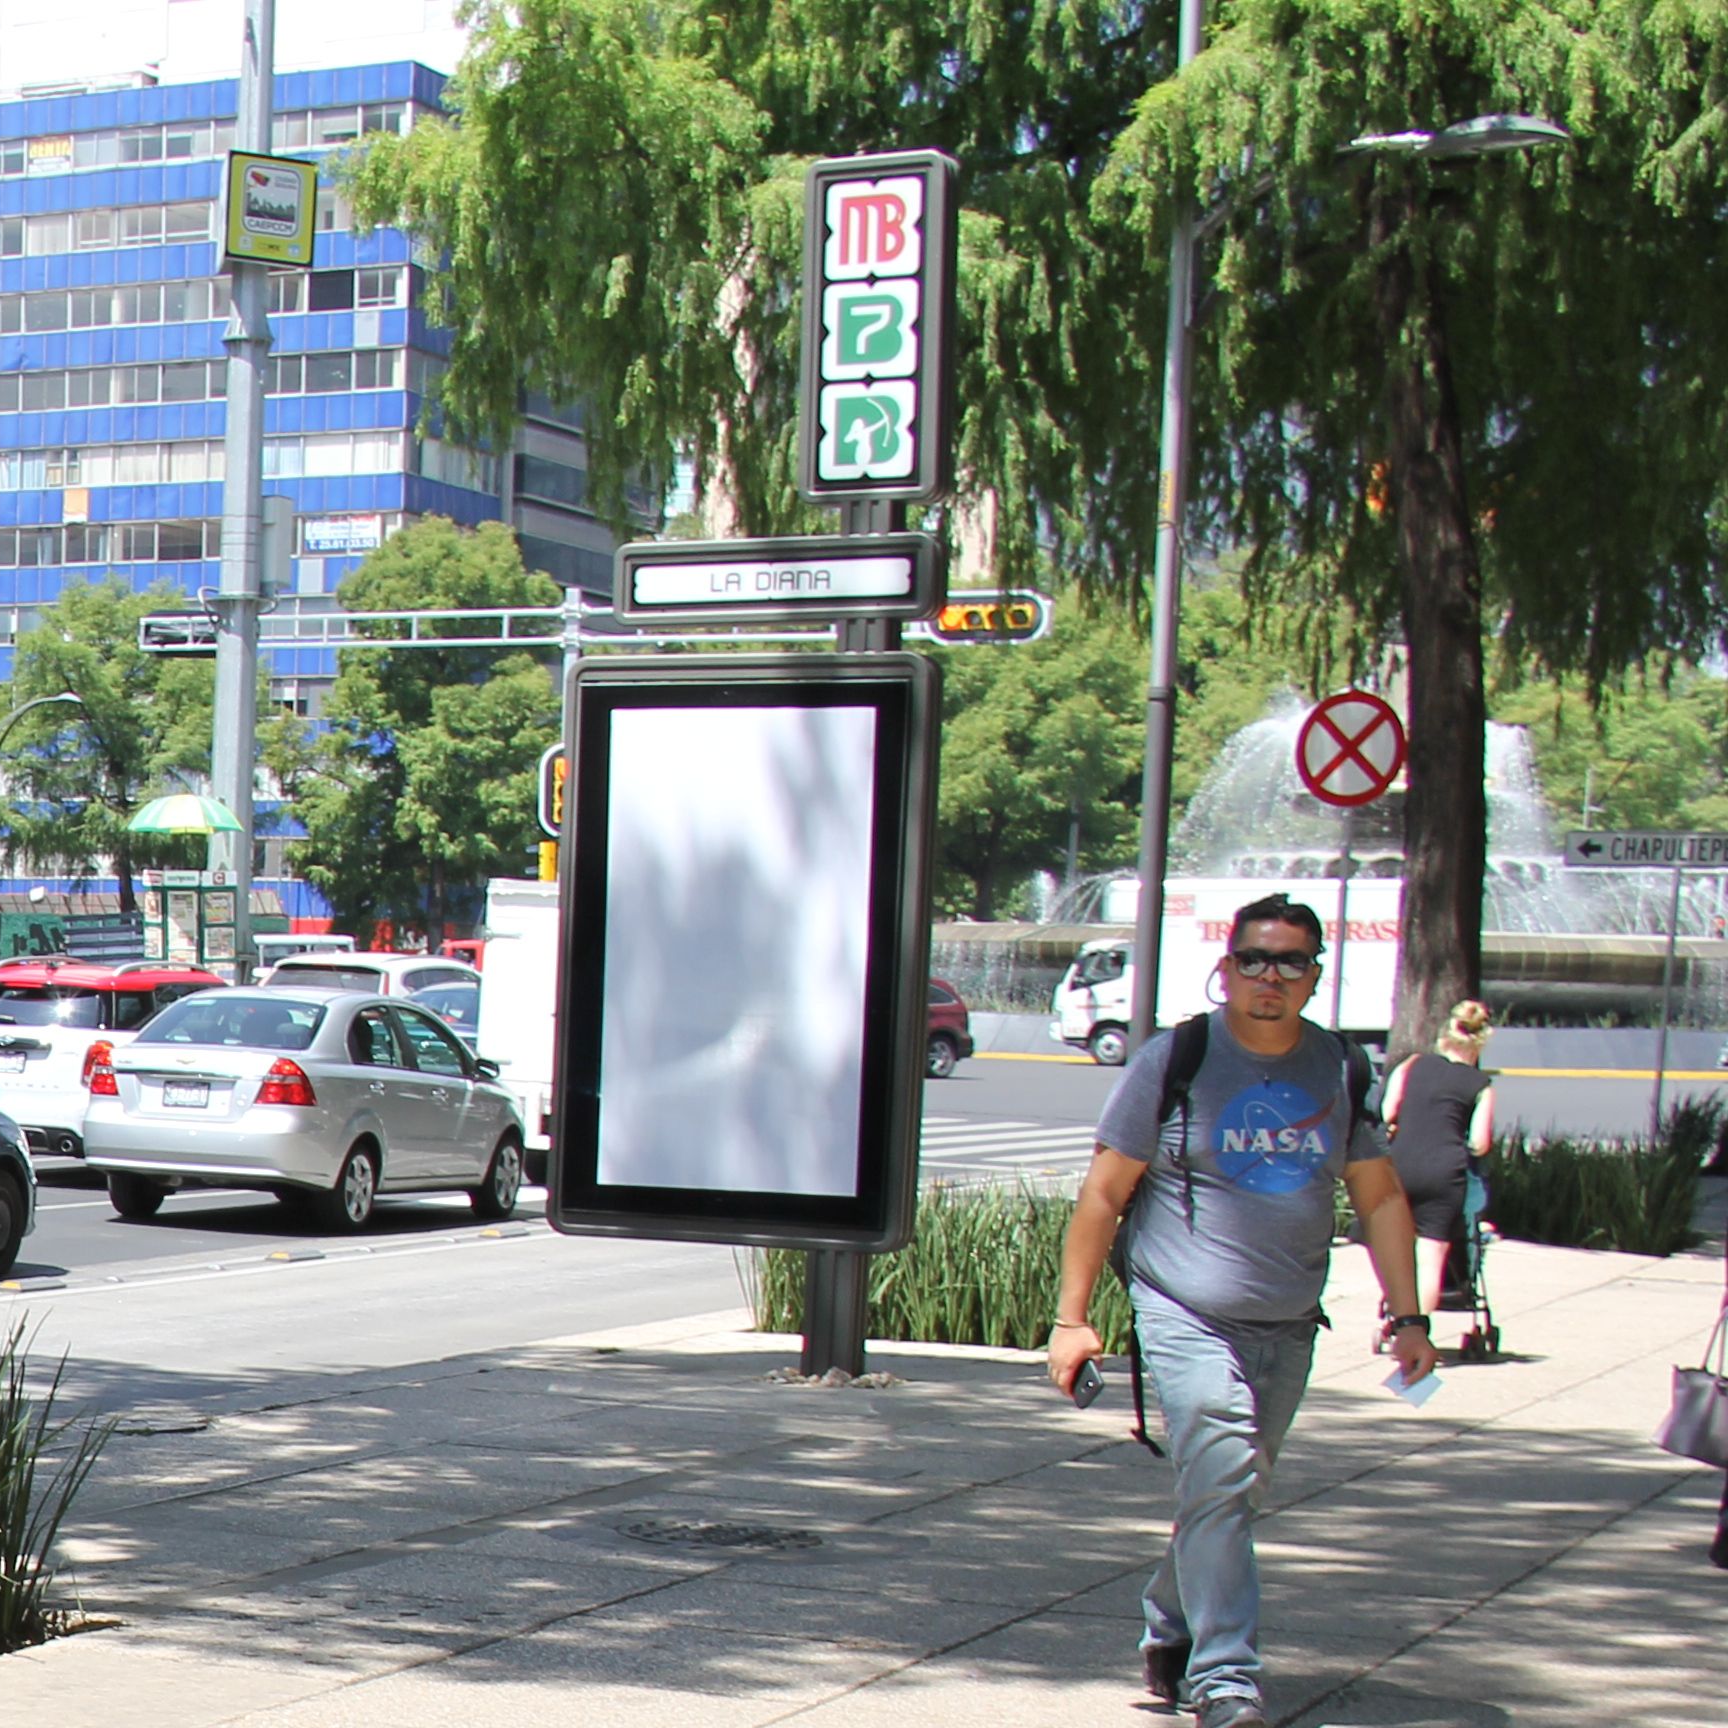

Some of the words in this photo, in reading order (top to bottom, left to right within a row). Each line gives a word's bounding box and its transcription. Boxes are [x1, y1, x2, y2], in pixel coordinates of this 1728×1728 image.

[839, 193, 906, 265] MB
[710, 572, 742, 592] LA
[755, 570, 831, 591] DIANA
[1222, 1128, 1326, 1154] NASA
